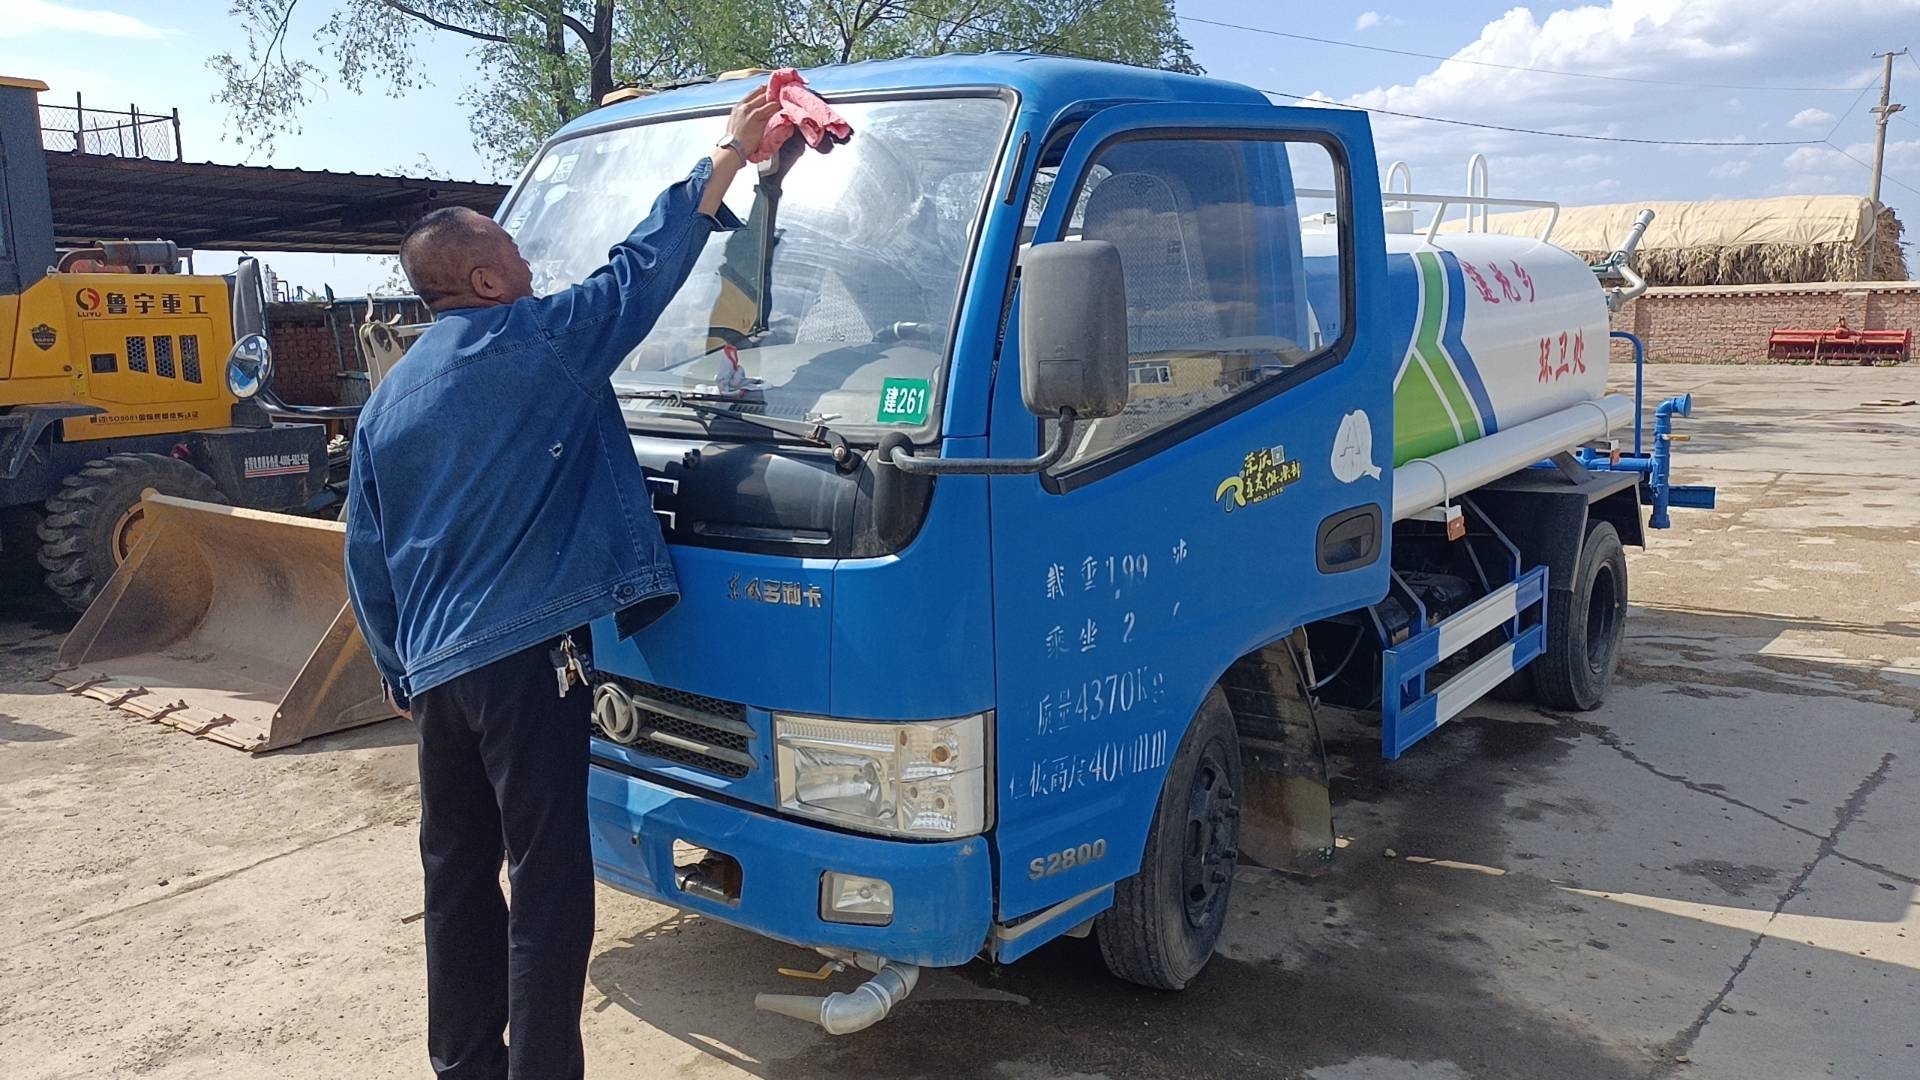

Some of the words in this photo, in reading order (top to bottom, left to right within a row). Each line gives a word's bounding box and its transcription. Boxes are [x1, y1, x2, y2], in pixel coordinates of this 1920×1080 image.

[106, 292, 208, 314] 鲁宇重工
[883, 386, 925, 414] 建261
[1028, 838, 1106, 881] S2800
